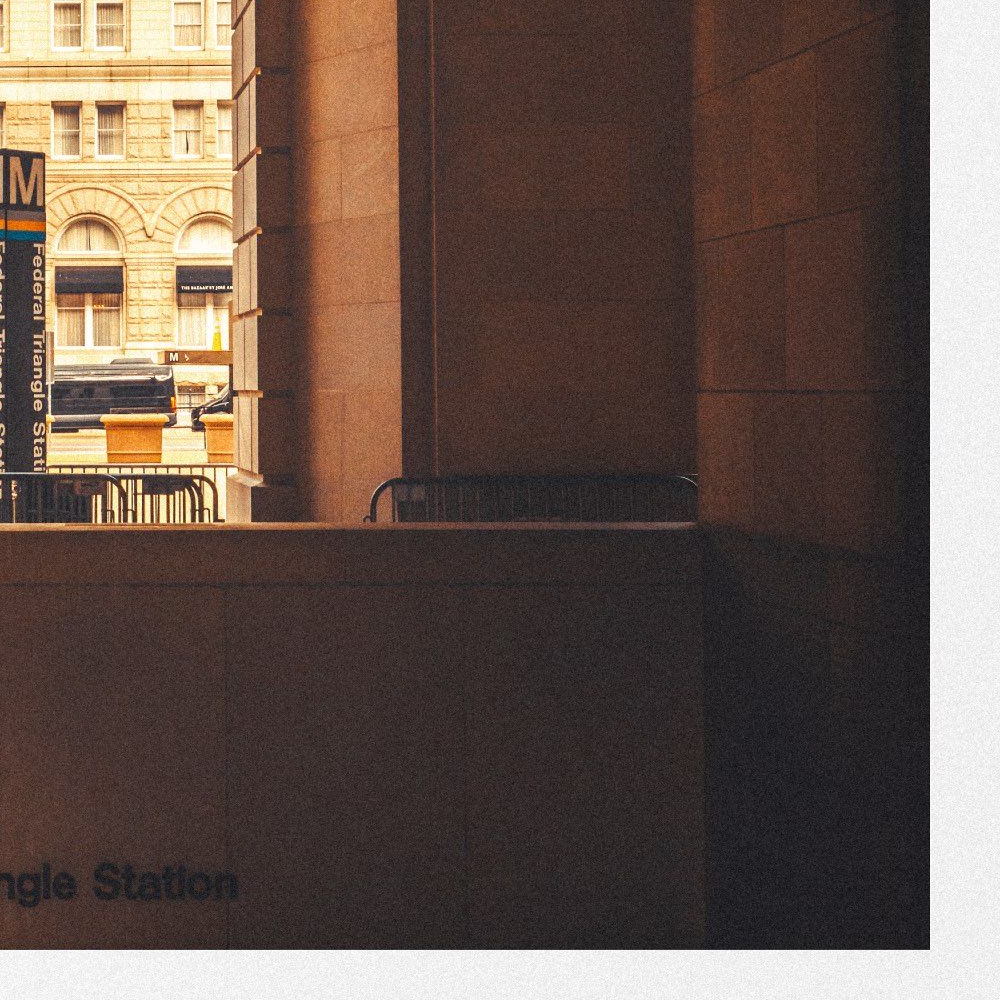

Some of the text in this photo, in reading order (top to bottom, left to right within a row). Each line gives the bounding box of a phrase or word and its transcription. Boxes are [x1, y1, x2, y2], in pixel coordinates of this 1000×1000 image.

[9, 156, 43, 206] M
[31, 243, 45, 472] Federal Triangle Stati
[169, 352, 179, 362] M
[93, 862, 238, 901] Station
